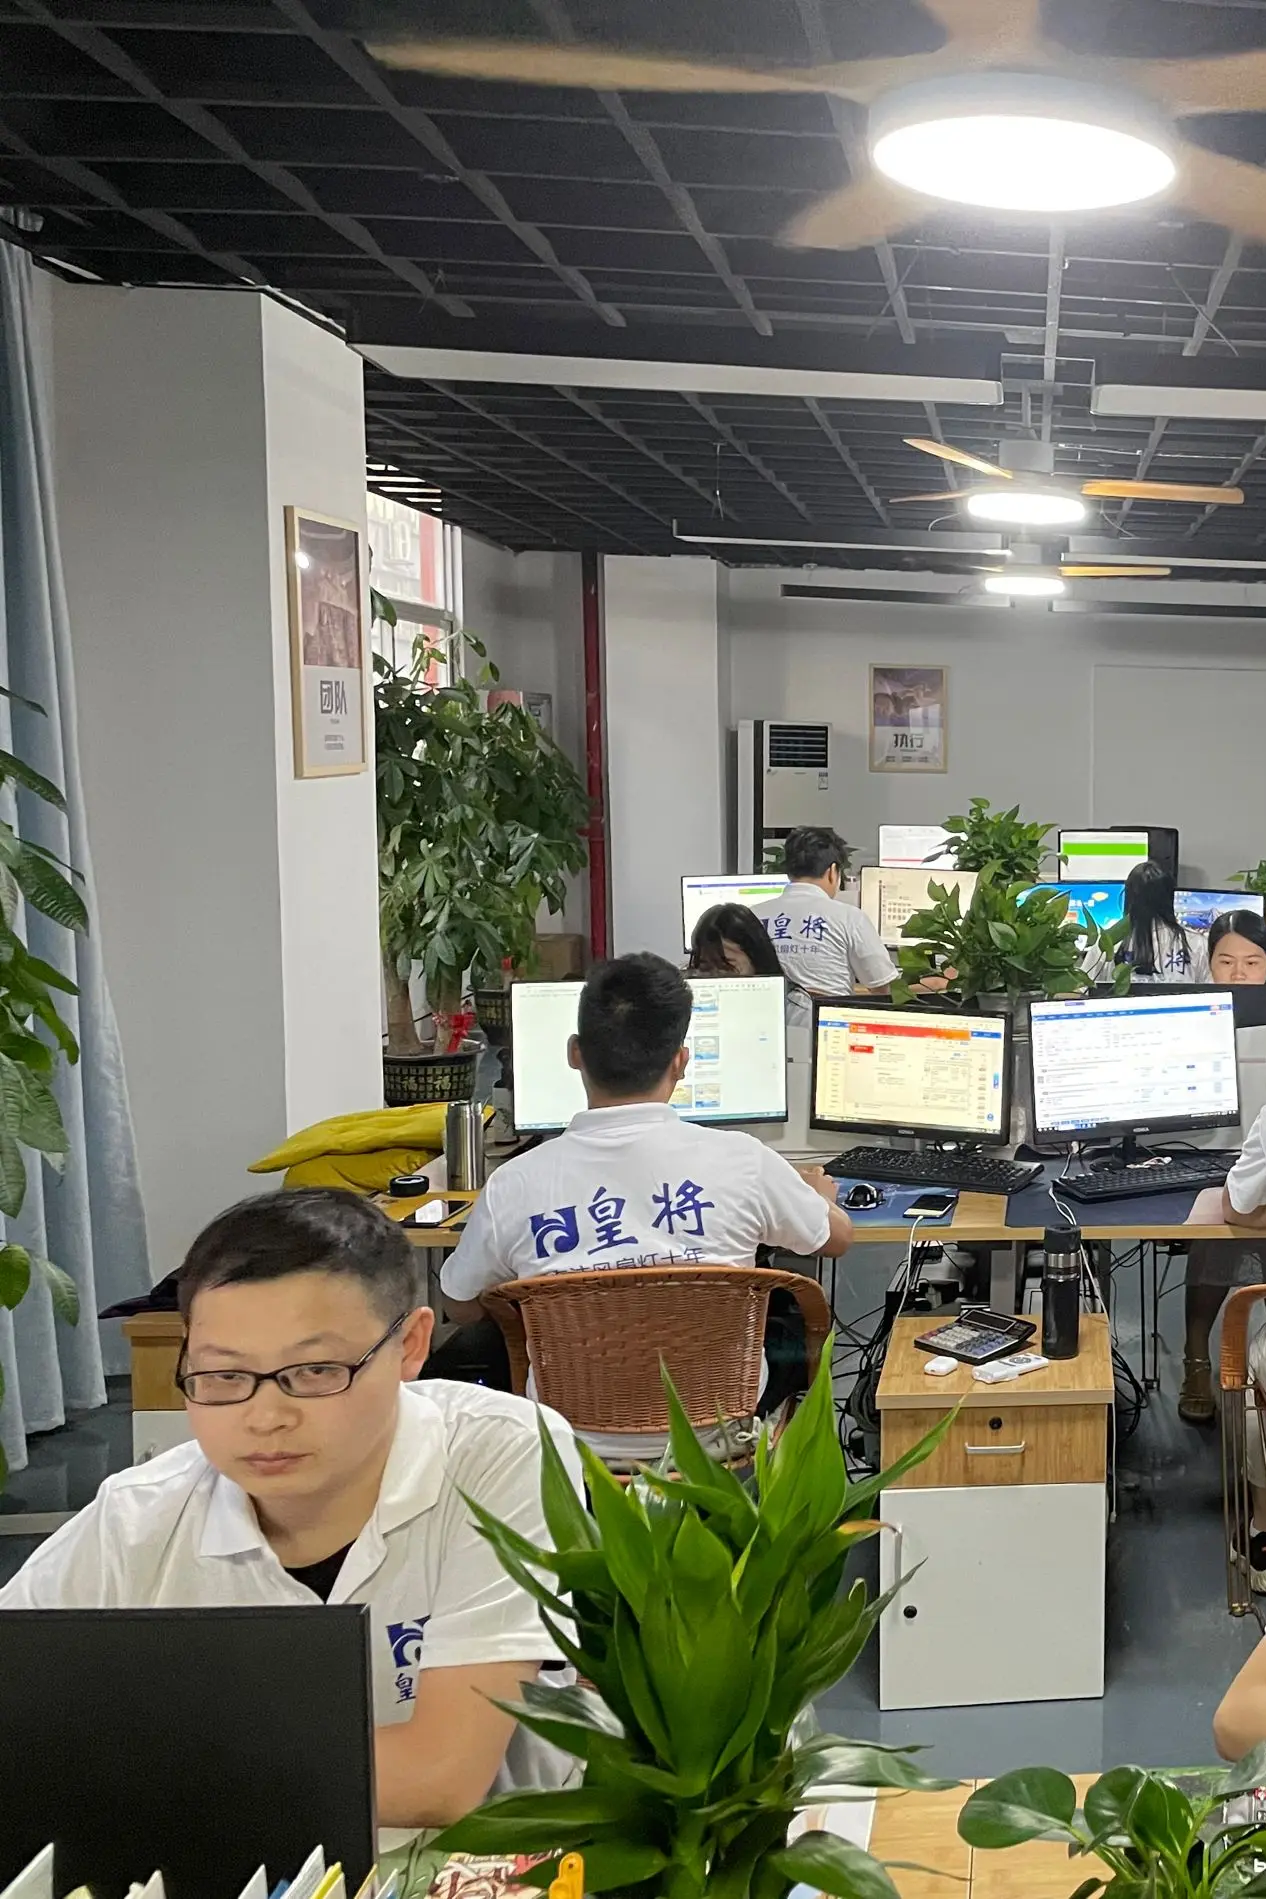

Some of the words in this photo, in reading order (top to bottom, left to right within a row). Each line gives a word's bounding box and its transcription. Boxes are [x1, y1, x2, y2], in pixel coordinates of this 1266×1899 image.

[320, 680, 347, 715] 团队
[770, 912, 829, 941] 皇将
[587, 1179, 715, 1255] 皇将
[550, 1247, 706, 1274] 扇灯十年
[395, 1672, 417, 1704] 皇
